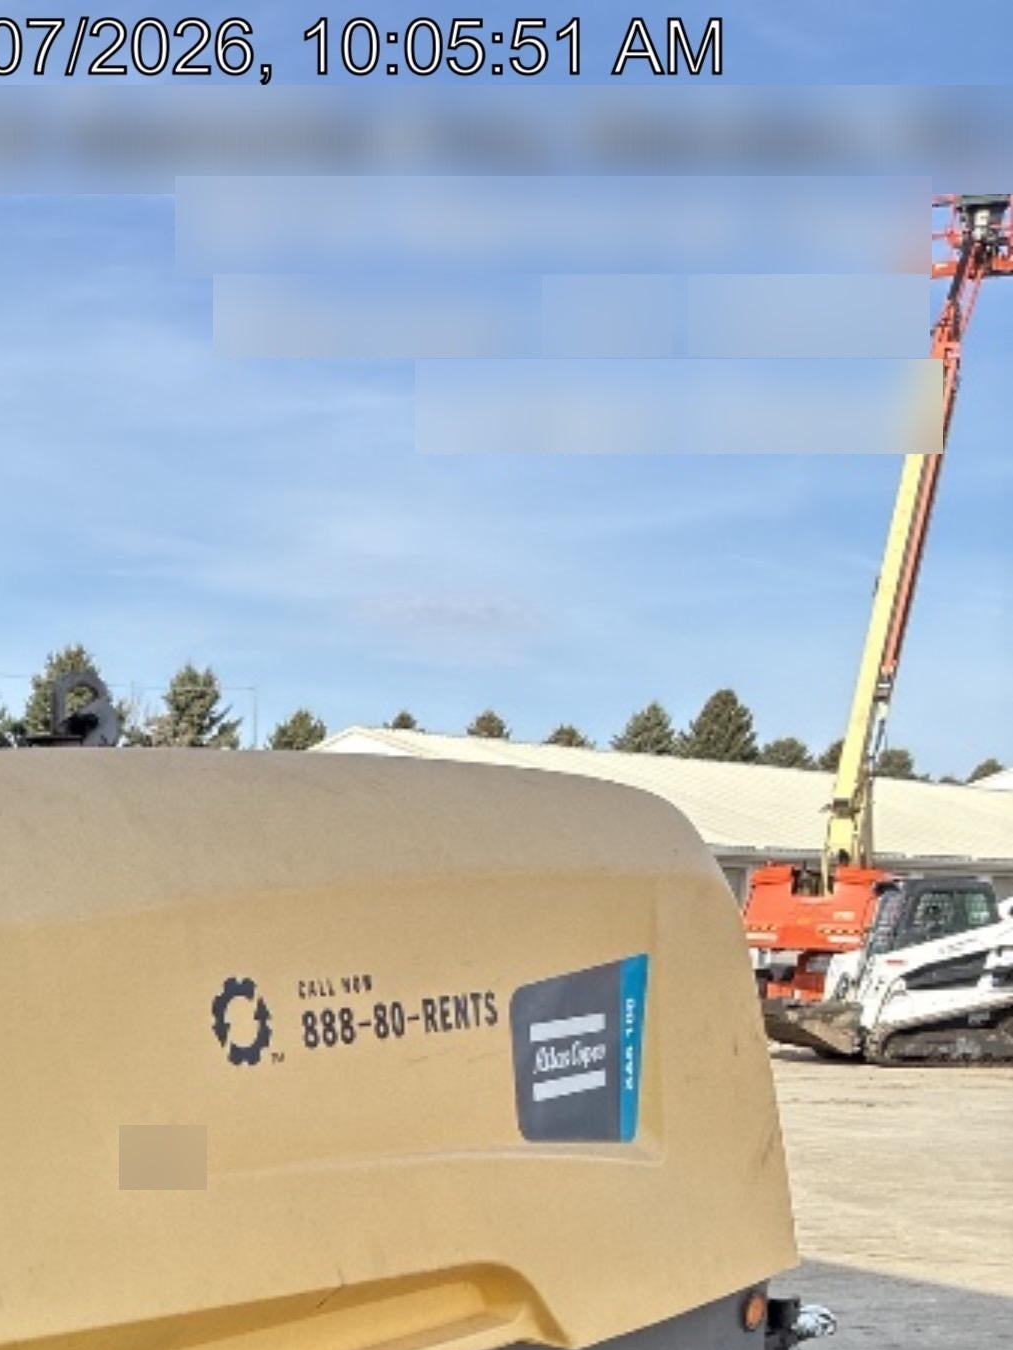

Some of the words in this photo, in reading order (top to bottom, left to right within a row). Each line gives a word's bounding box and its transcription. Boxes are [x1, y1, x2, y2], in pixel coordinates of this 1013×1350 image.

[298, 978, 336, 999] CALL
[340, 974, 373, 994] NOW
[301, 990, 499, 1049] 888-80-RENTS
[533, 1046, 570, 1075] Atlas
[571, 1040, 606, 1068] Copco
